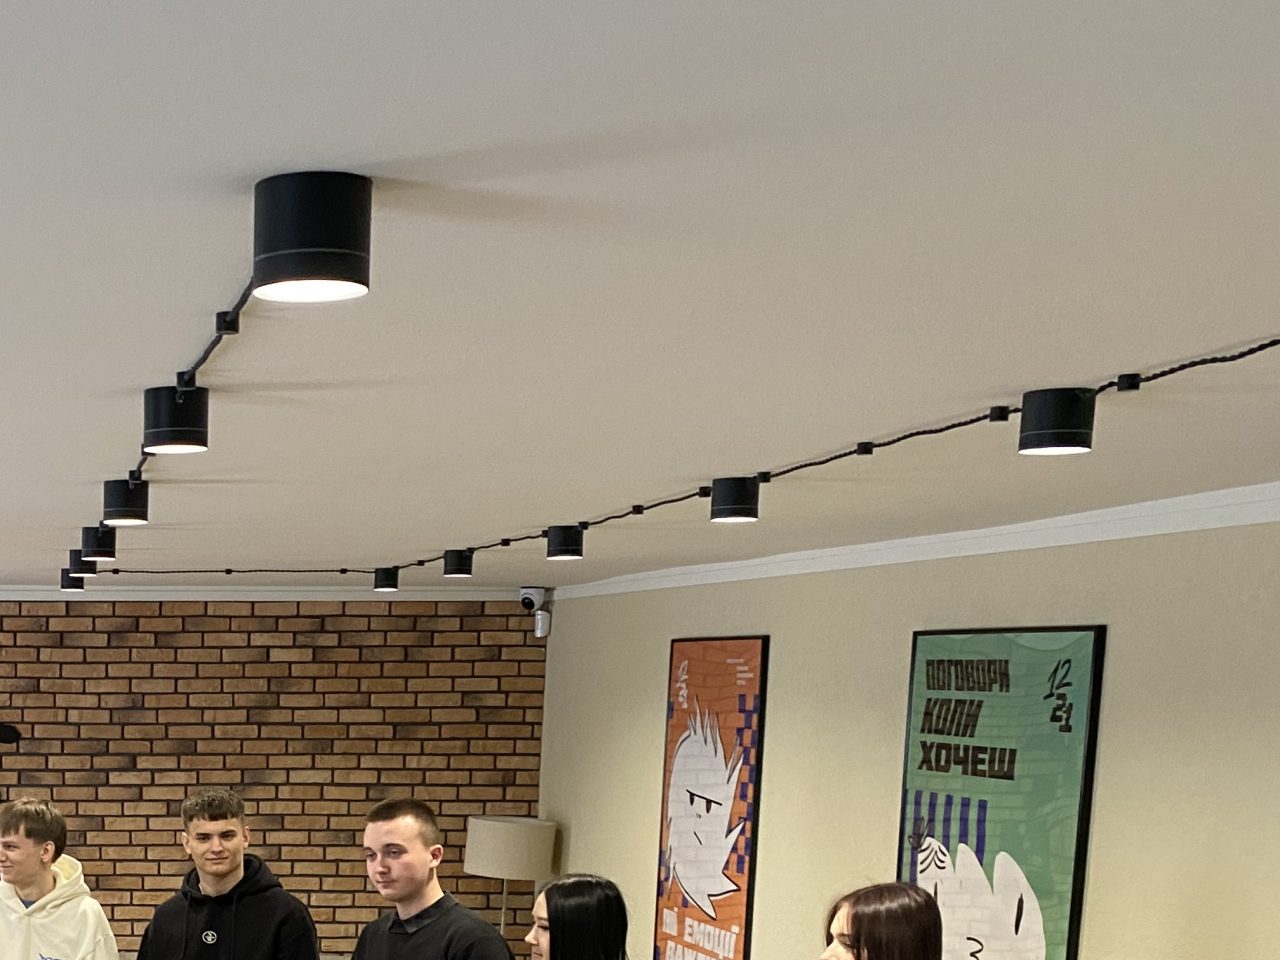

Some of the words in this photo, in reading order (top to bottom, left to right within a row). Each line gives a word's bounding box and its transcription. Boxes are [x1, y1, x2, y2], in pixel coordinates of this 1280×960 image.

[925, 658, 1010, 693] ПОГОВОРИ
[1043, 658, 1073, 700] 12
[920, 697, 984, 738] КОЛИ
[1049, 692, 1073, 733] 21
[917, 740, 1017, 781] ХОЧЕШ
[683, 917, 739, 960] ЕМОЦІЇ
